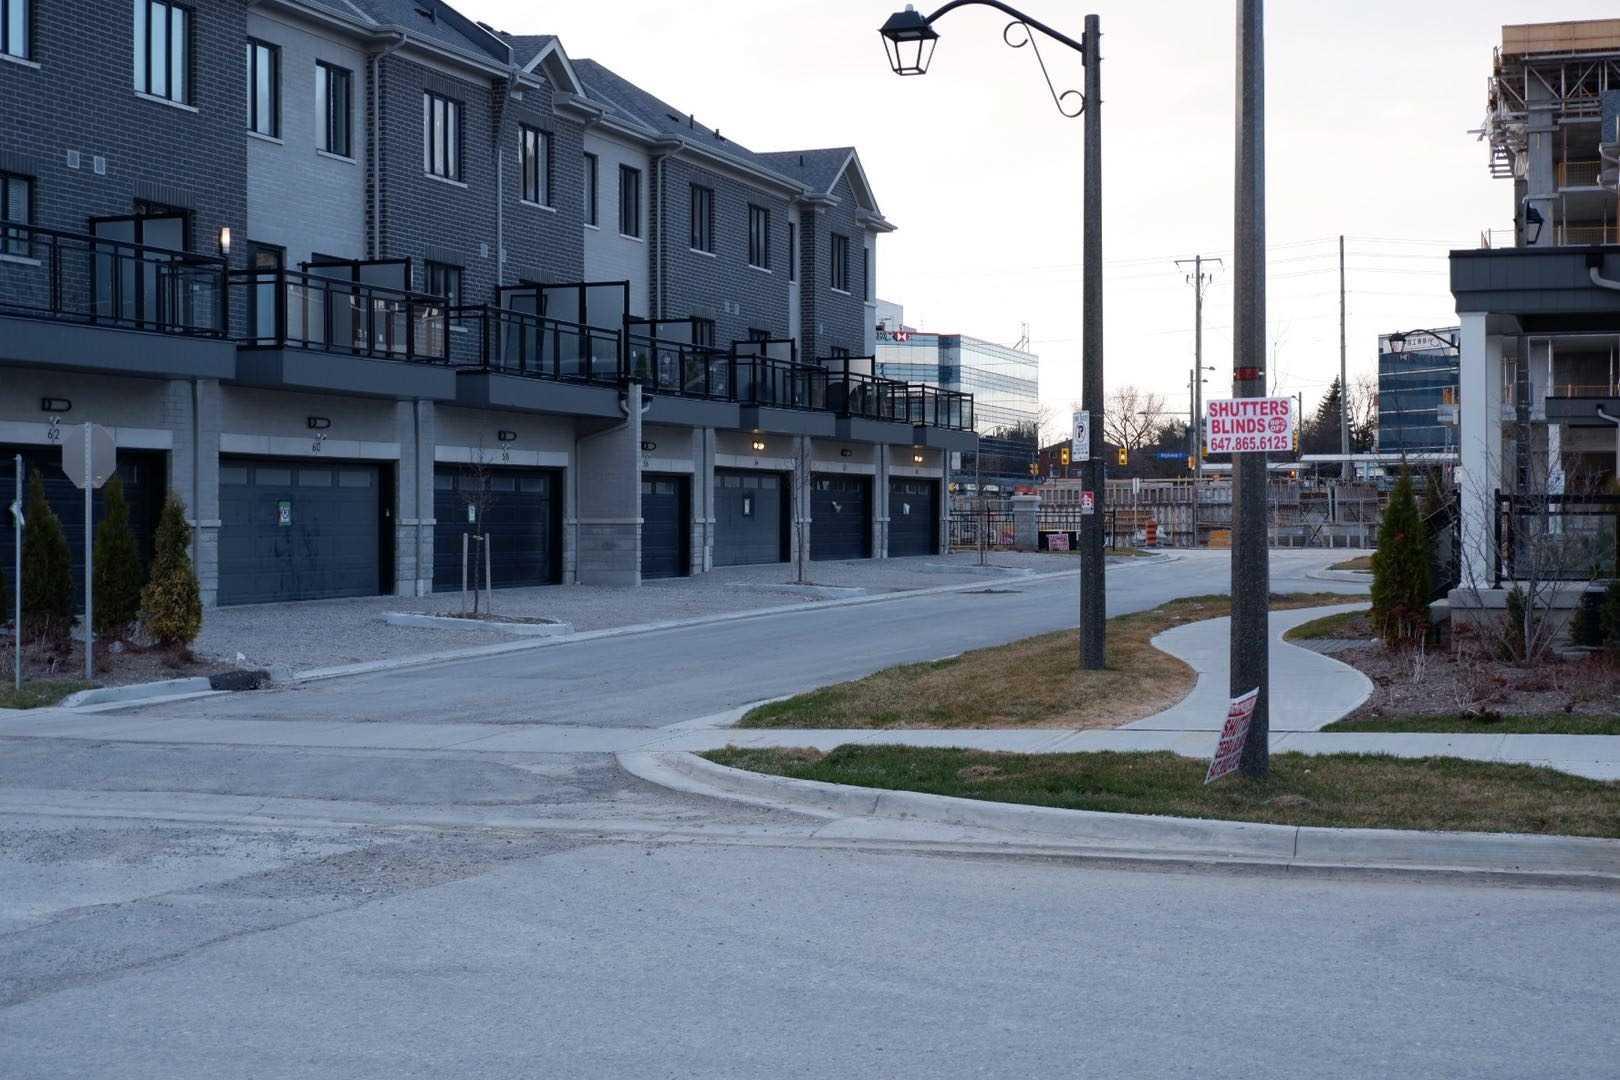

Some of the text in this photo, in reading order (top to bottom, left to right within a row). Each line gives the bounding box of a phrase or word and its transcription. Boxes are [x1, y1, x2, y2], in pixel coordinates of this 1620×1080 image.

[1209, 400, 1289, 417] SHUTTERS
[47, 428, 60, 439] 62
[1211, 418, 1266, 434] BLINDS
[1210, 436, 1288, 451] 647.865.6125
